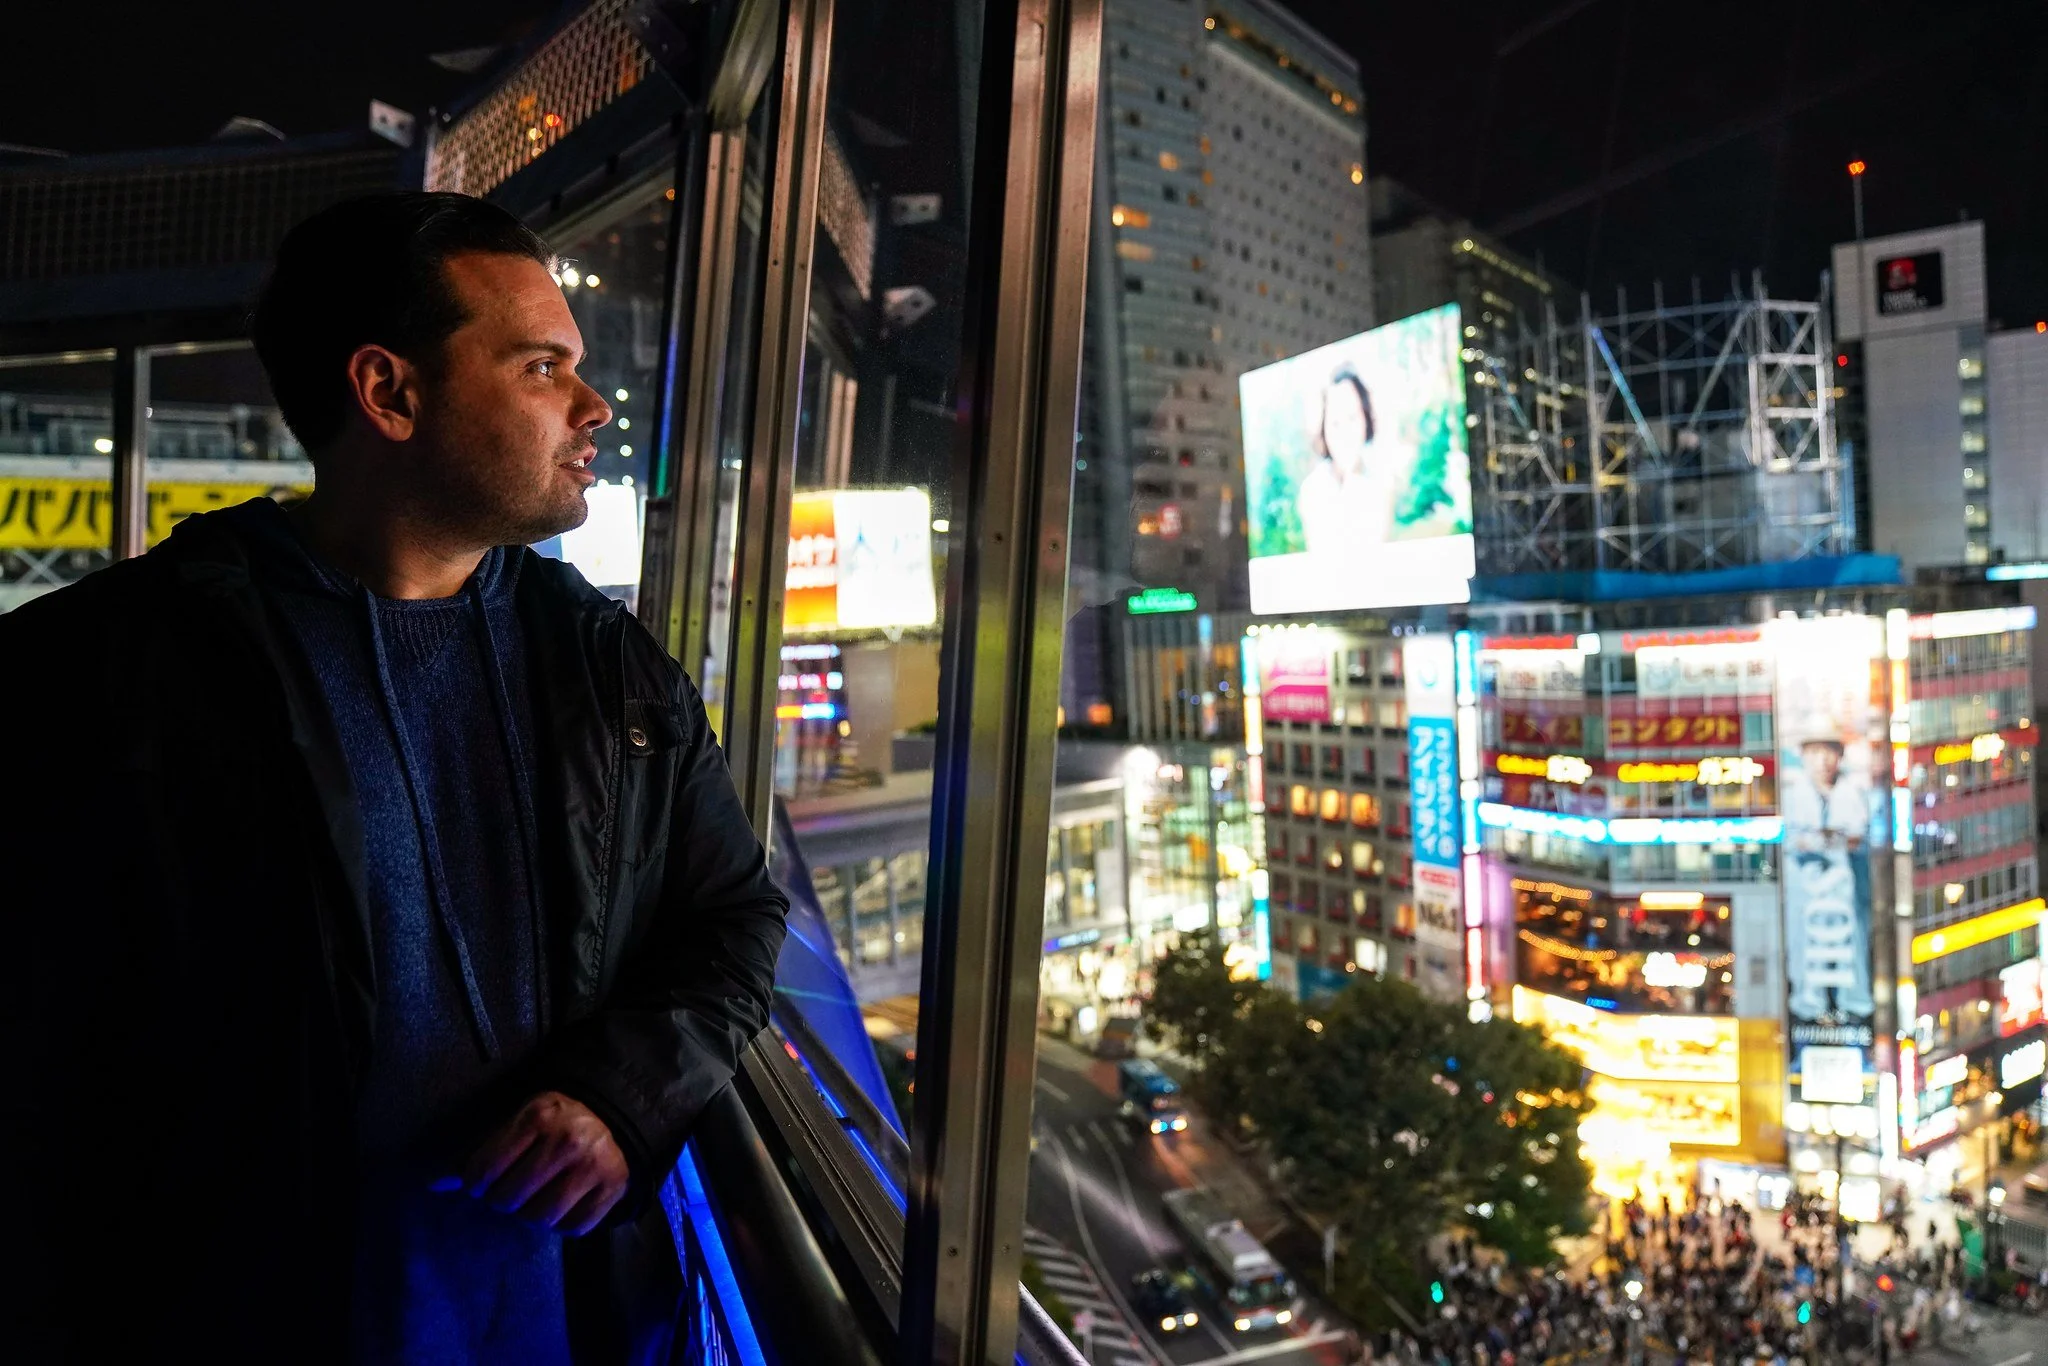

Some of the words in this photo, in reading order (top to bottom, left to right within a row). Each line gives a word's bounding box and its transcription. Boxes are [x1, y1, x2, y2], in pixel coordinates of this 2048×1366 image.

[1611, 716, 1739, 745] コンタクト
